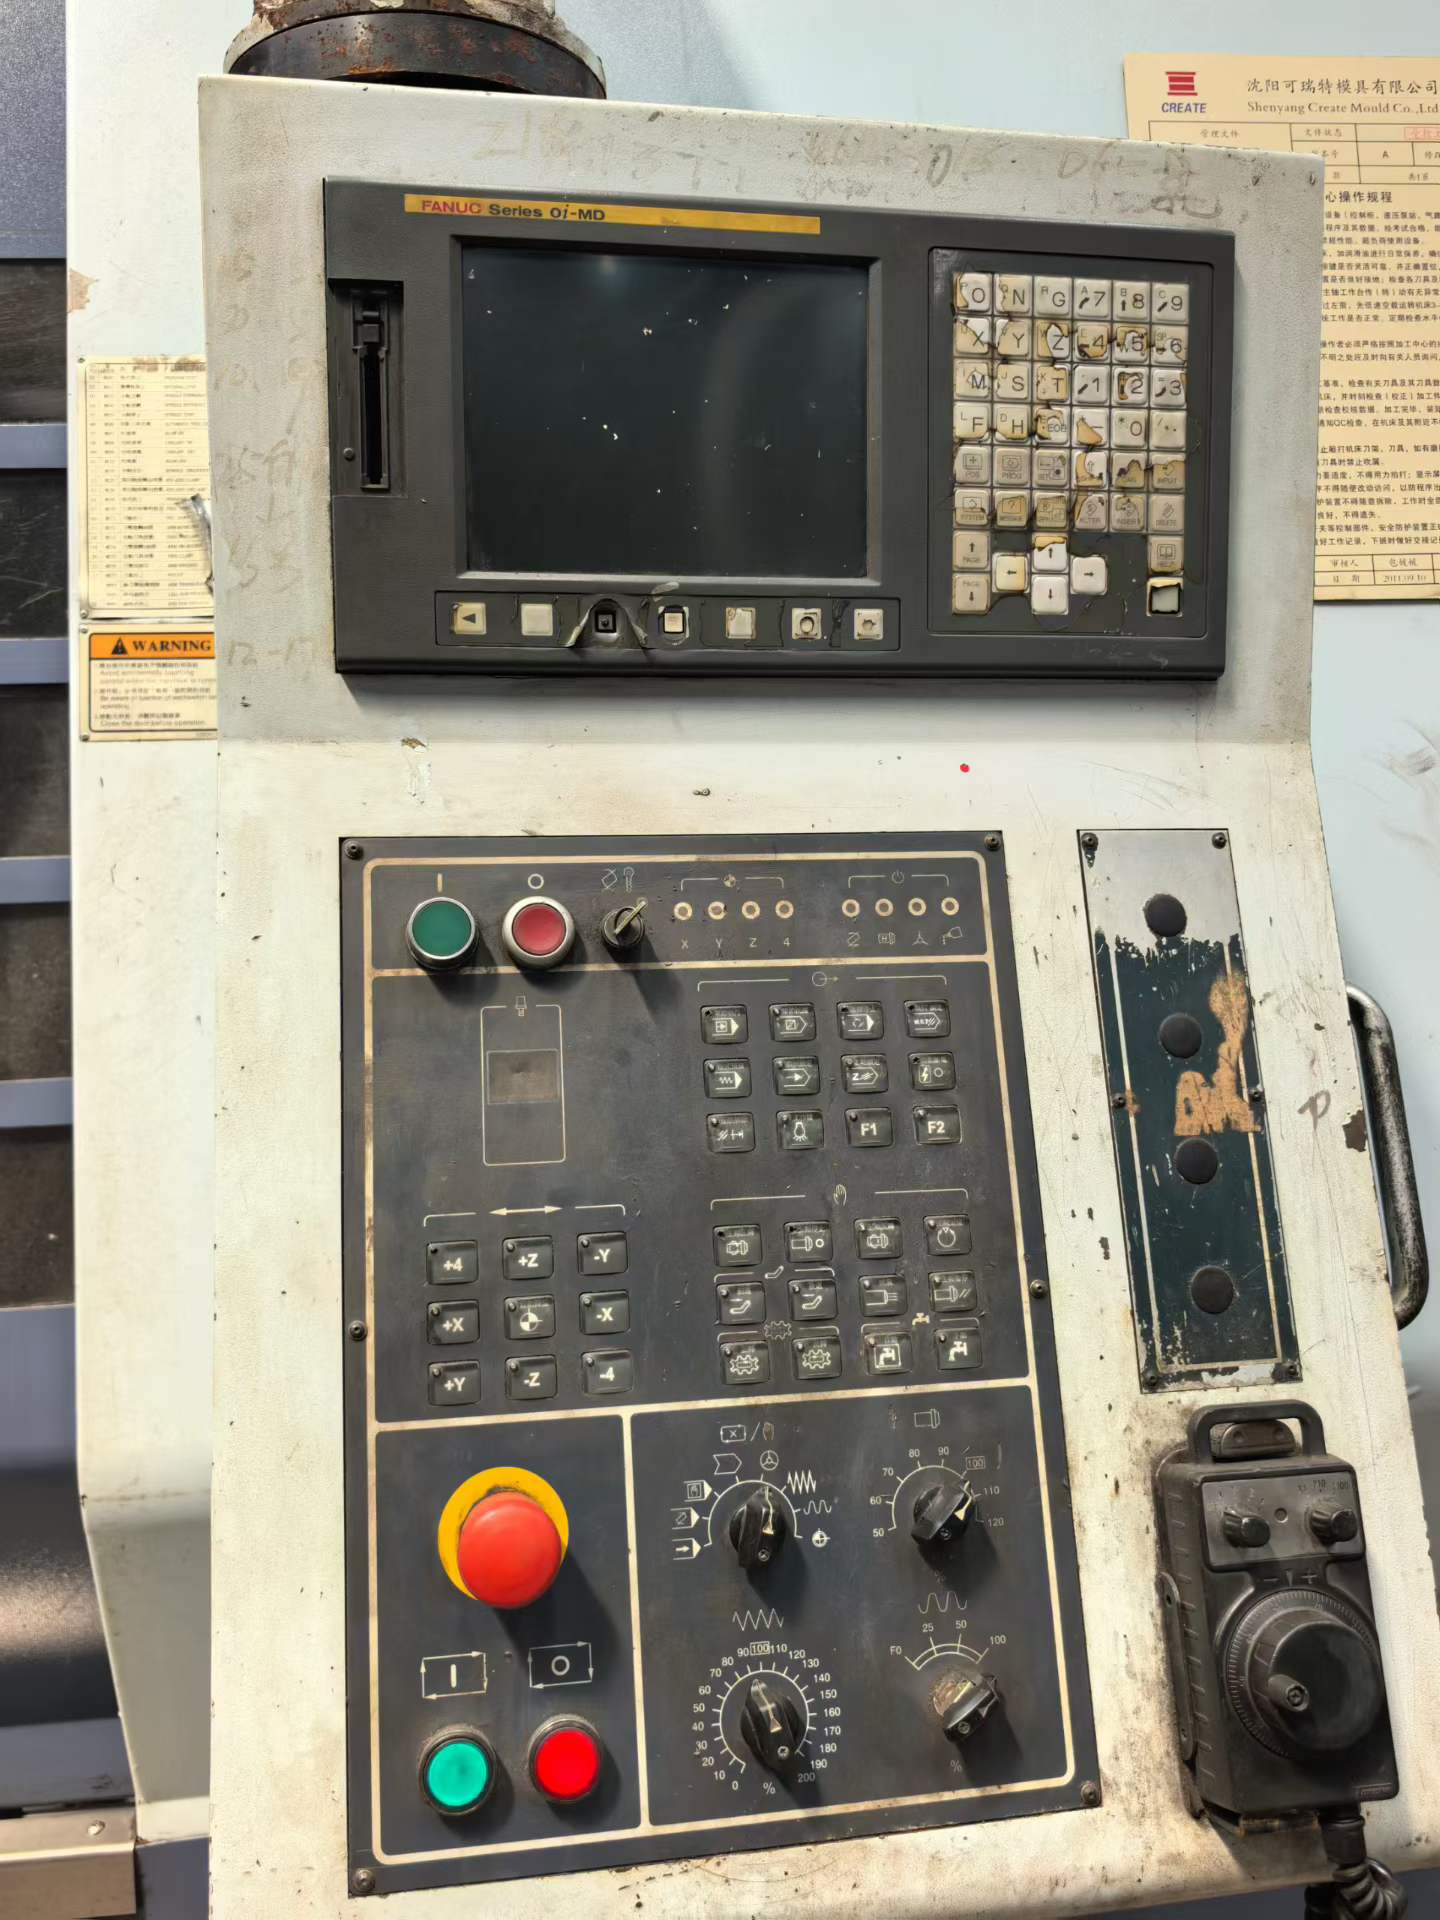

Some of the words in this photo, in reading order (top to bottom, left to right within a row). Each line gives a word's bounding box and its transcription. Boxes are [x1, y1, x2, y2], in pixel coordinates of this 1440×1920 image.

[1247, 78, 1438, 95] 沈阳可瑞特模具有限公司
[1161, 102, 1207, 114] CREATE
[1247, 101, 1304, 114] Shenyang
[1308, 102, 1347, 113] Create
[1350, 102, 1390, 113] Mould
[1200, 128, 1239, 138] 管理文件
[1304, 128, 1342, 138] 文件状态
[1382, 150, 1390, 159] A
[421, 200, 482, 215] FANUC
[488, 203, 543, 218] Series
[972, 288, 986, 304] O
[1012, 290, 1025, 305] N
[1052, 292, 1066, 307] G
[1080, 286, 1088, 294] A
[1093, 291, 1106, 306] 7
[1132, 294, 1145, 309] 8
[1170, 295, 1183, 311] 9
[973, 332, 984, 346] X
[1012, 333, 1025, 348] Y
[1052, 335, 1064, 350] Z
[1092, 334, 1104, 349] 4
[1132, 336, 1144, 352] 5
[1170, 338, 1182, 354] 6
[971, 376, 987, 389] M
[1012, 376, 1024, 392] S
[1052, 378, 1066, 392] T
[1093, 378, 1100, 392] 1
[1132, 378, 1144, 394] 2
[1169, 380, 1182, 396] 3
[972, 417, 984, 432] F
[1012, 419, 1024, 434] H
[132, 640, 212, 652] WARNING
[681, 939, 688, 949] X
[716, 938, 723, 948] Y
[750, 938, 758, 948] Z
[783, 938, 790, 947] 4
[860, 1122, 878, 1136] F1
[928, 1121, 946, 1135] F2
[594, 1248, 610, 1262] -Y
[443, 1258, 464, 1272] +4
[518, 1254, 538, 1268] +Z
[596, 1308, 614, 1322] -X
[442, 1318, 464, 1332] +X
[524, 1372, 540, 1386] -Z
[600, 1366, 614, 1381] -4
[444, 1377, 466, 1392] +Y
[908, 1448, 920, 1458] 80
[938, 1446, 950, 1456] 90
[968, 1458, 984, 1468] 100
[882, 1468, 894, 1476] 70
[983, 1486, 1000, 1496] 110
[870, 1496, 882, 1505] 60
[988, 1518, 1004, 1527] 120
[872, 1528, 884, 1538] 50
[922, 1622, 934, 1633] 25
[956, 1620, 967, 1630] 50
[990, 1634, 1007, 1645] 100
[737, 1647, 749, 1657] 90
[752, 1644, 768, 1654] 100
[770, 1644, 787, 1654] 110
[890, 1646, 902, 1656] F0
[789, 1650, 806, 1660] 120
[722, 1656, 734, 1666] 80
[802, 1658, 820, 1668] 130
[710, 1668, 722, 1678] 70
[814, 1672, 830, 1682] 140
[698, 1685, 711, 1695] 60
[820, 1689, 837, 1699] 150
[693, 1703, 705, 1713] 50
[824, 1706, 841, 1717] 160
[692, 1722, 704, 1731] 40
[824, 1726, 842, 1736] 170
[696, 1740, 708, 1750] 30
[820, 1743, 837, 1754] 180
[702, 1756, 714, 1766] 20
[810, 1758, 828, 1769] 190
[714, 1770, 726, 1780] 10
[798, 1772, 816, 1782] 200
[732, 1781, 738, 1790] 0
